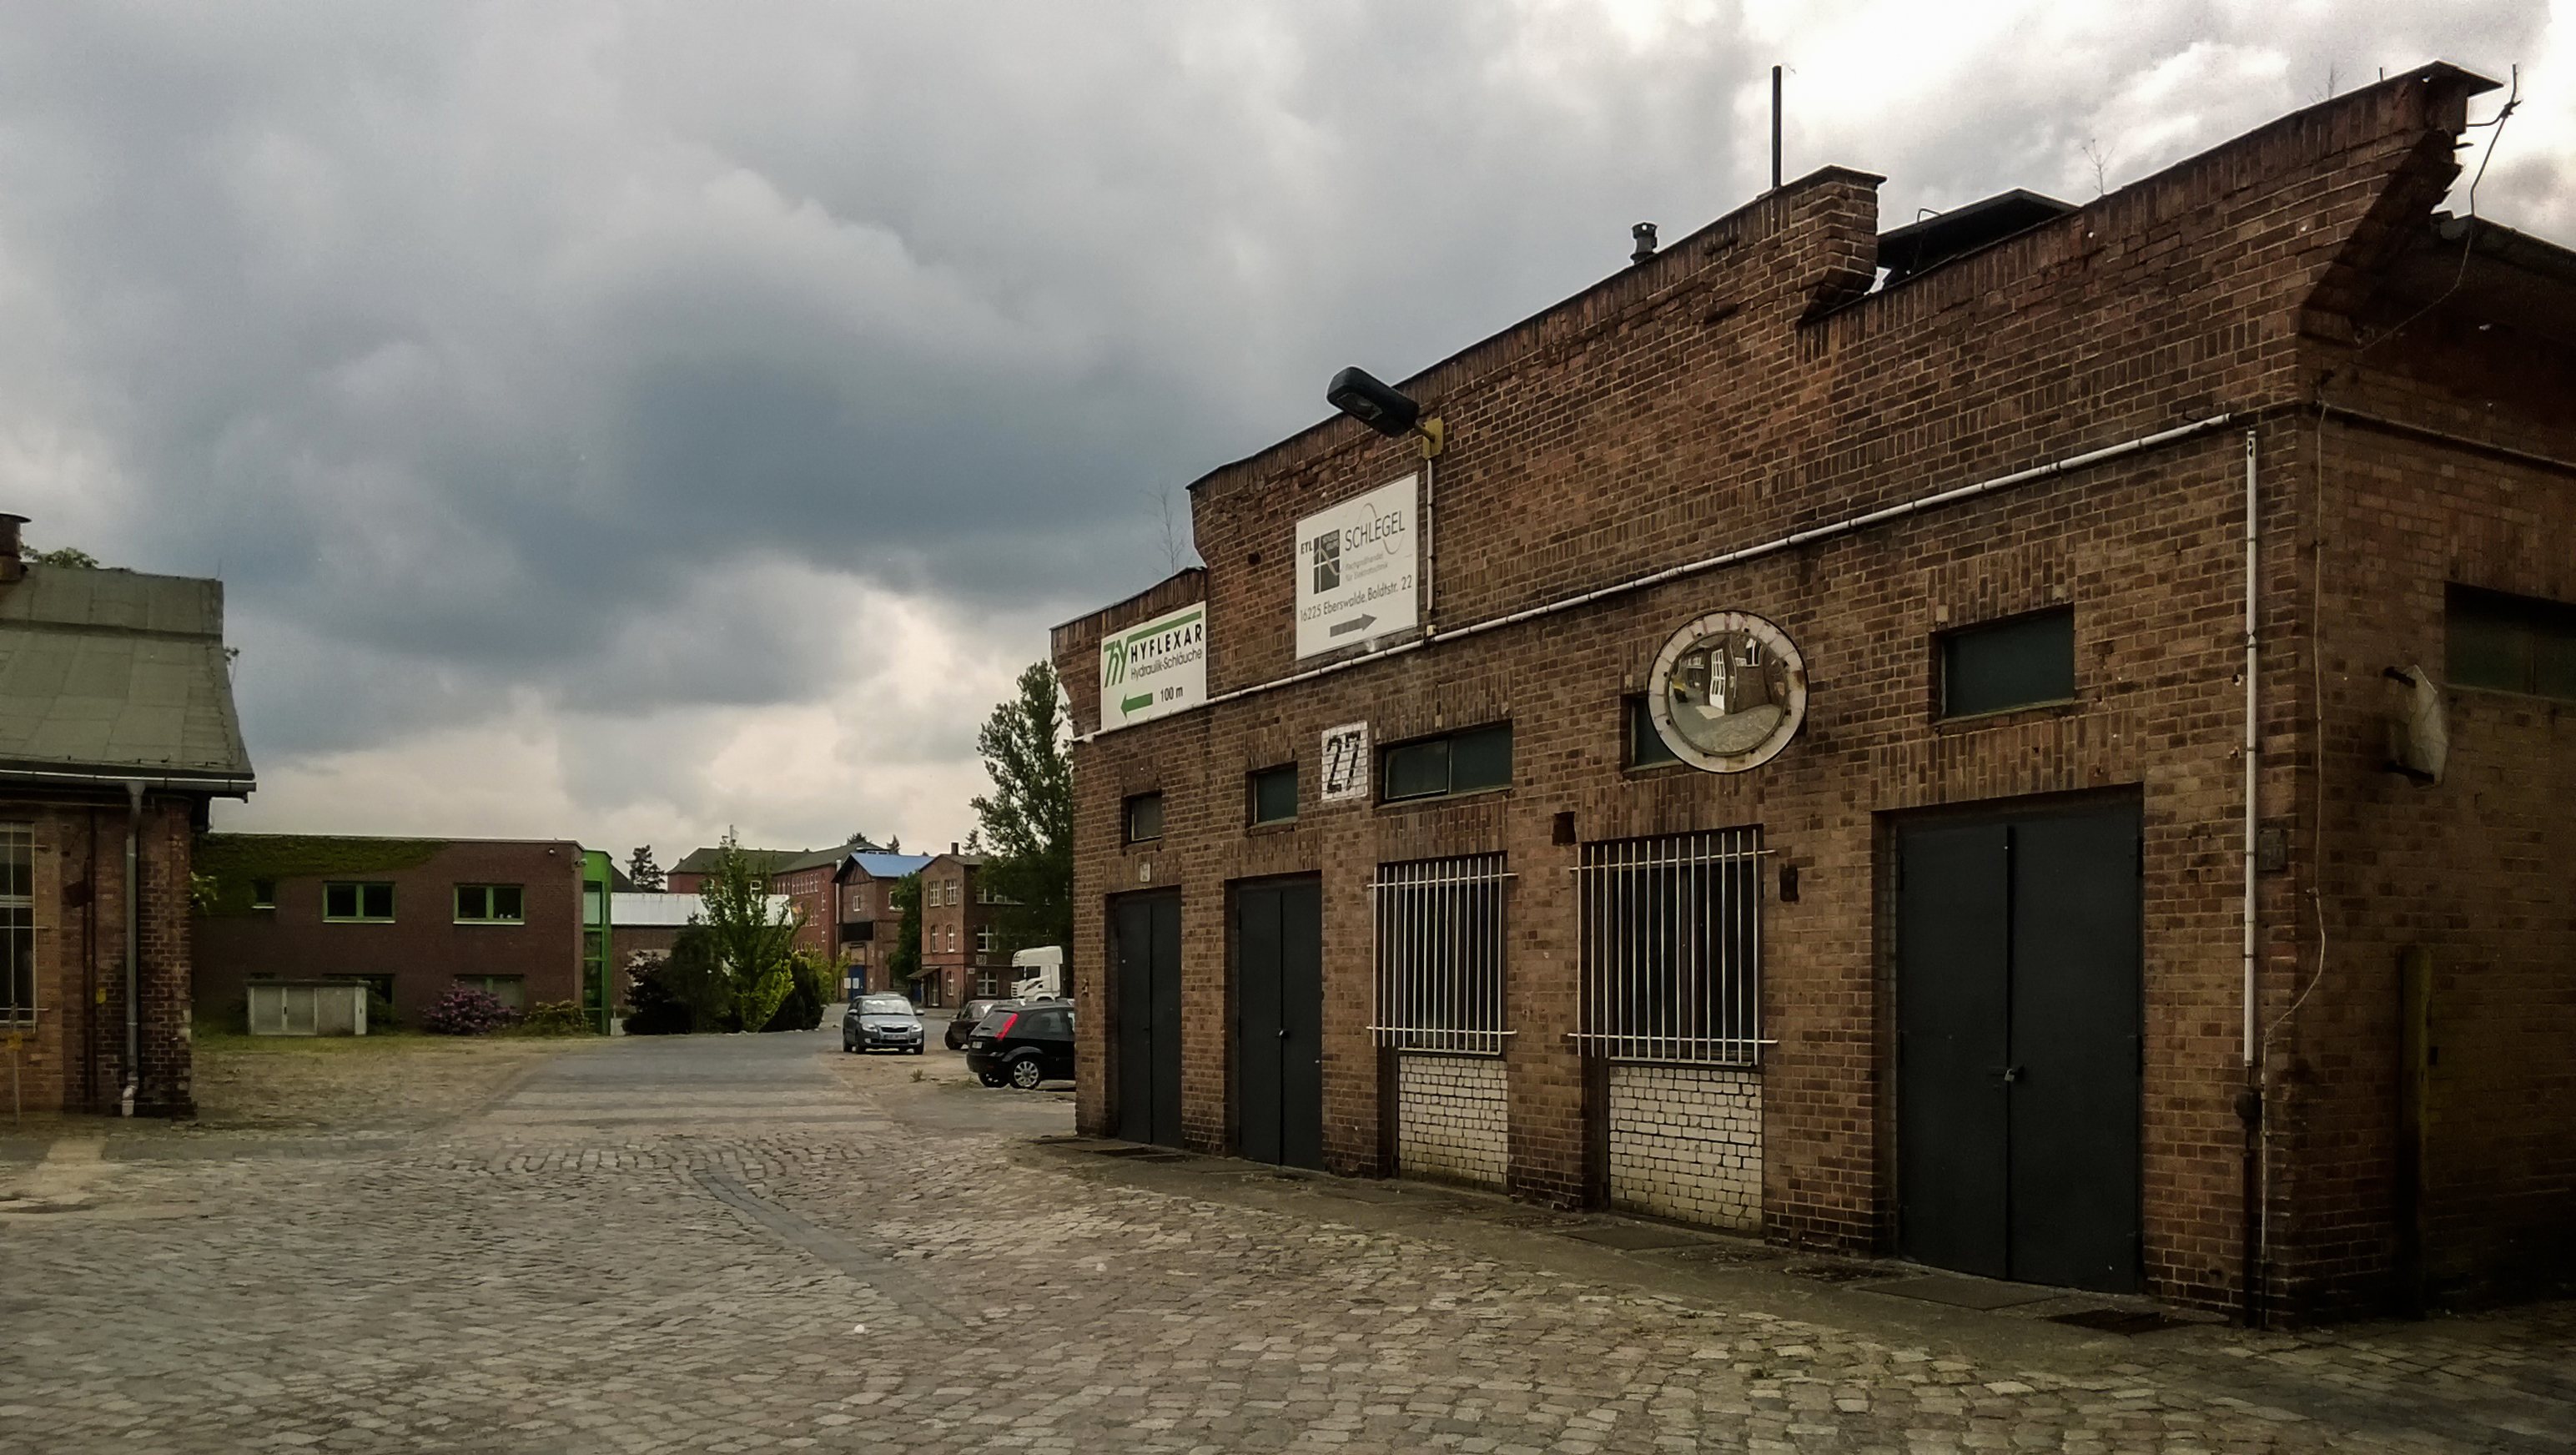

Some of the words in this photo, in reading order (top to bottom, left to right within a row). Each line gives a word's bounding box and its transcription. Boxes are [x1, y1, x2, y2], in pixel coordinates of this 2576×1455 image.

[1301, 540, 1313, 555] ETL
[1345, 511, 1406, 551] SCHLEGEL
[1300, 604, 1321, 622] 16225
[1401, 574, 1412, 591] 22
[1130, 623, 1202, 664] HYFLEXAR
[1130, 647, 1203, 681] Hydraulik-Schläuche
[1160, 687, 1175, 702] 100
[1175, 687, 1184, 698] m
[1326, 729, 1361, 794] 27
